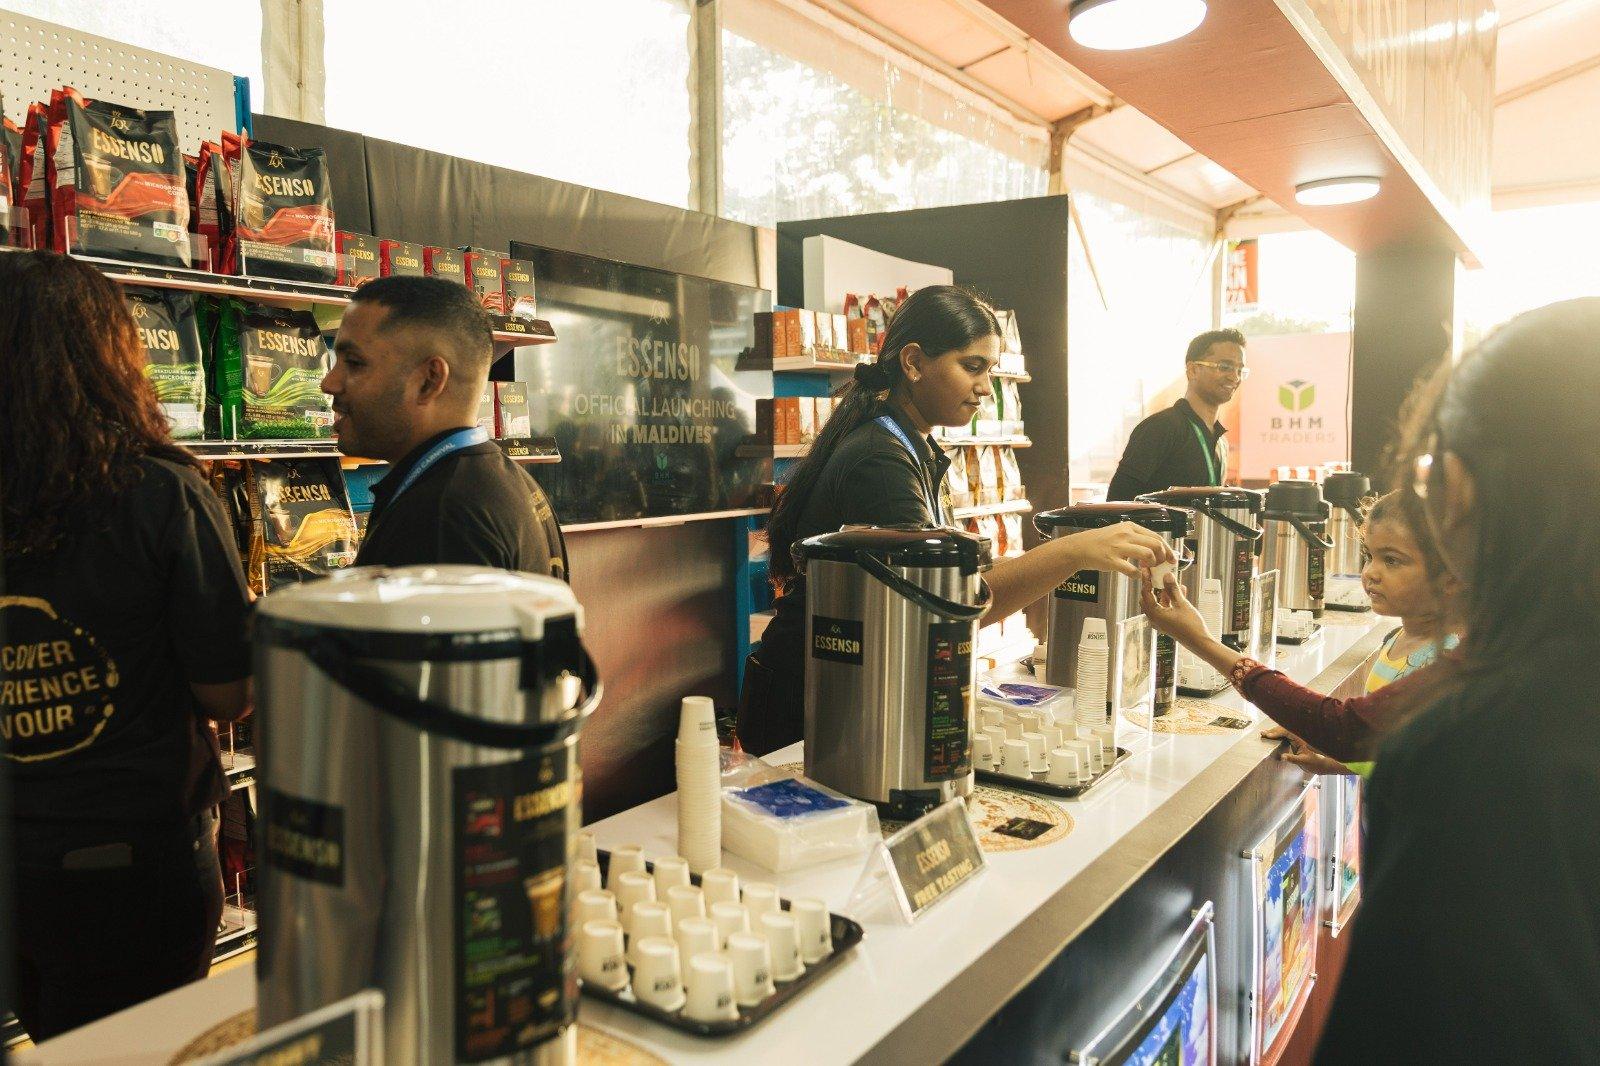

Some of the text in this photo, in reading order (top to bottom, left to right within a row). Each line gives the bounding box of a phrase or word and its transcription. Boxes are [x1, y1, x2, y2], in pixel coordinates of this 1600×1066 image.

[91, 126, 165, 164] ESSENSO
[349, 248, 375, 261] ESSENSO
[395, 256, 419, 268] ESSENSO
[438, 262, 460, 273] ESSENSO
[476, 267, 497, 278] ESSENSO
[508, 272, 530, 282] ESSENSO
[137, 327, 180, 351] ENSO
[258, 329, 317, 357] ESSENSO
[616, 336, 700, 382] ESSENSO
[574, 394, 737, 420] OFFICIAL LAUNCHING
[1271, 417, 1323, 429] BHM
[611, 424, 712, 444] IN MALDIVES
[1260, 432, 1336, 443] TRADERS
[814, 633, 860, 654] ESSENSO
[2, 640, 75, 672] COVER
